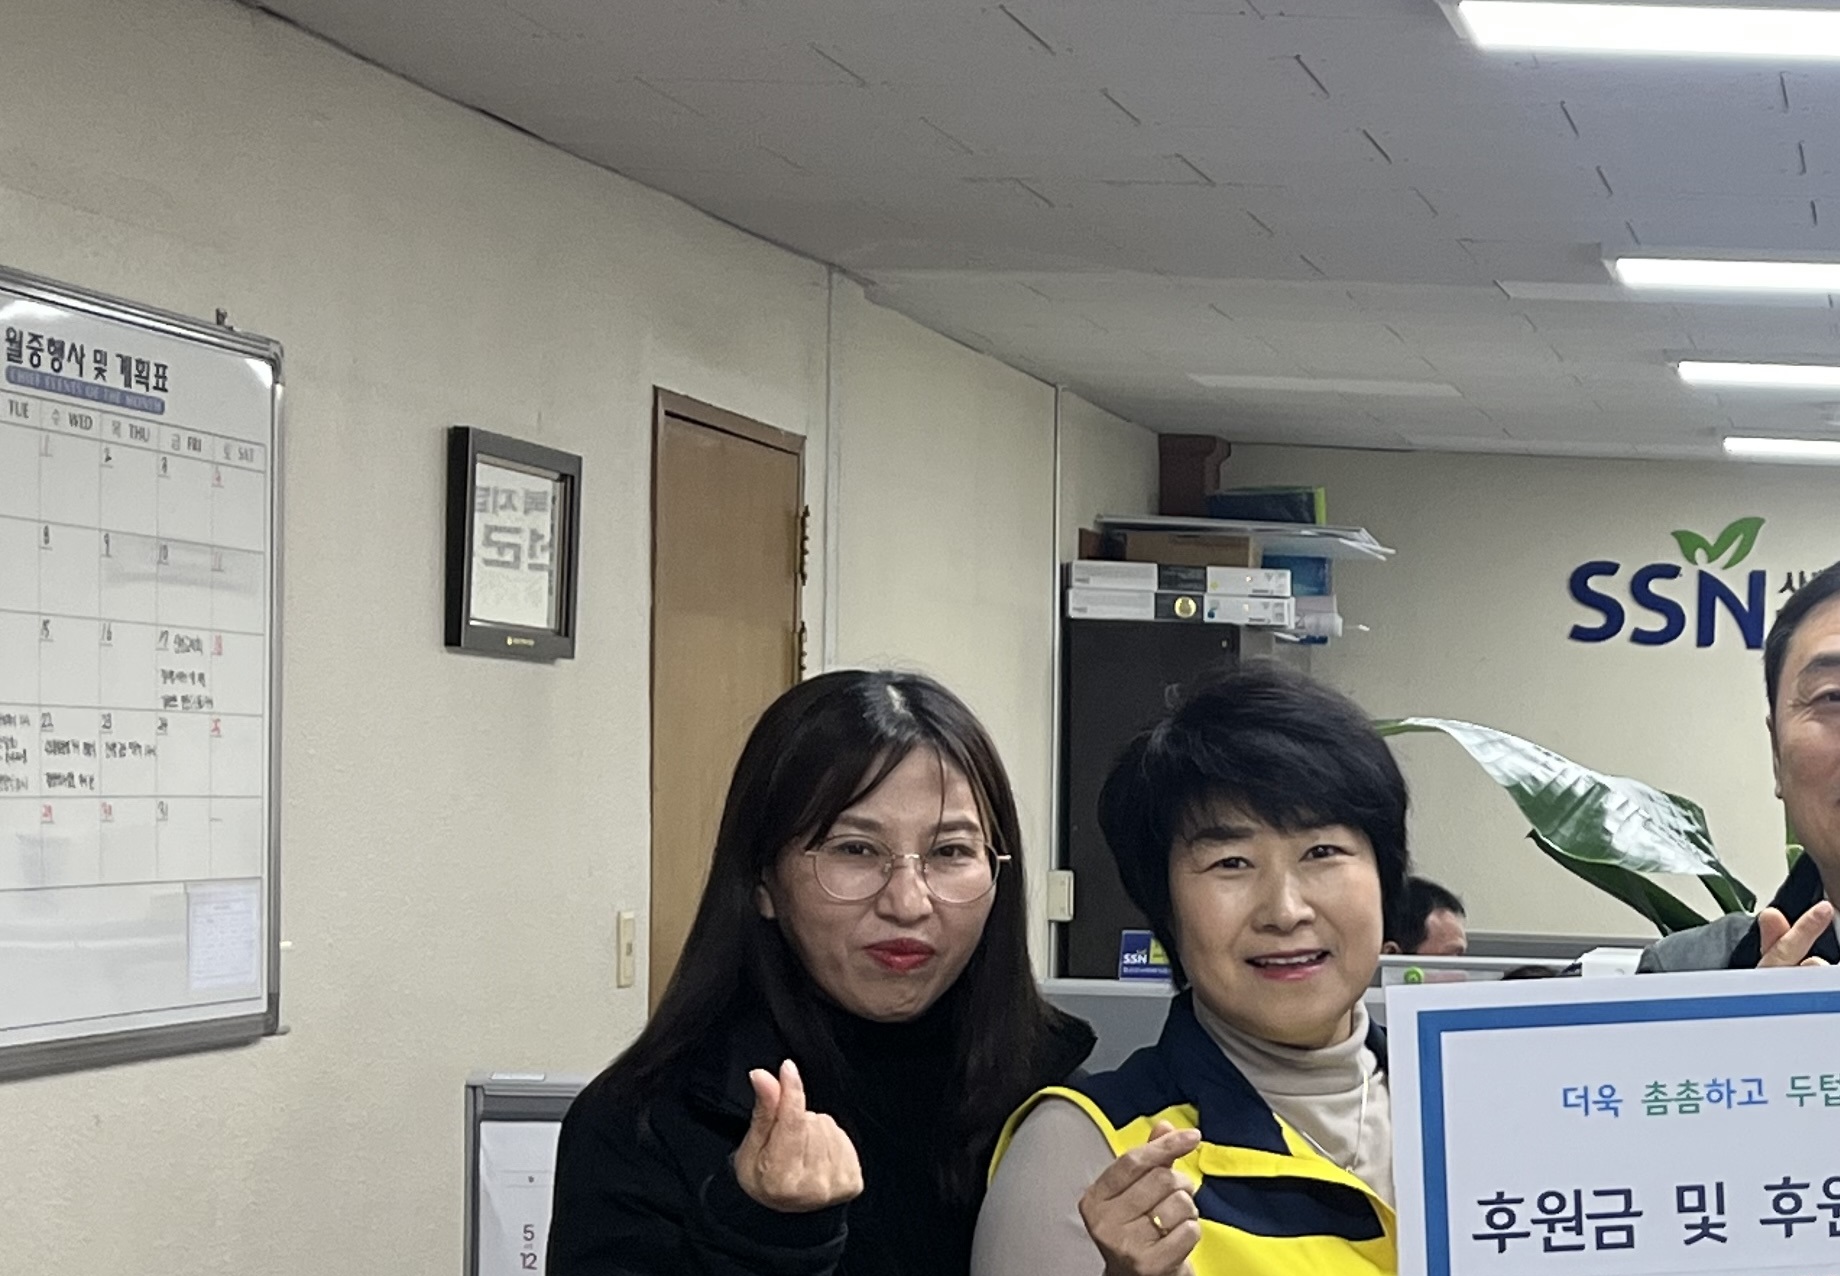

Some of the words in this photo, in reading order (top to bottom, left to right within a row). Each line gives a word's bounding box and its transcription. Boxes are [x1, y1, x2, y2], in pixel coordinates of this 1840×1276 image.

[5, 326, 85, 377] 월중행사
[93, 350, 108, 381] 및
[116, 353, 169, 393] 계획표
[8, 400, 29, 418] TUE
[69, 413, 93, 430] WED
[129, 424, 151, 442] THU
[1568, 560, 1766, 650] SSN
[103, 621, 113, 641] 16
[1123, 953, 1147, 964] SSN
[1561, 1085, 1623, 1117] 더욱
[1641, 1078, 1769, 1116] 촘촘하고
[1471, 1187, 1644, 1253] 후원금
[1675, 1180, 1730, 1245] 및
[523, 1224, 535, 1241] 5
[520, 1252, 538, 1270] 12
